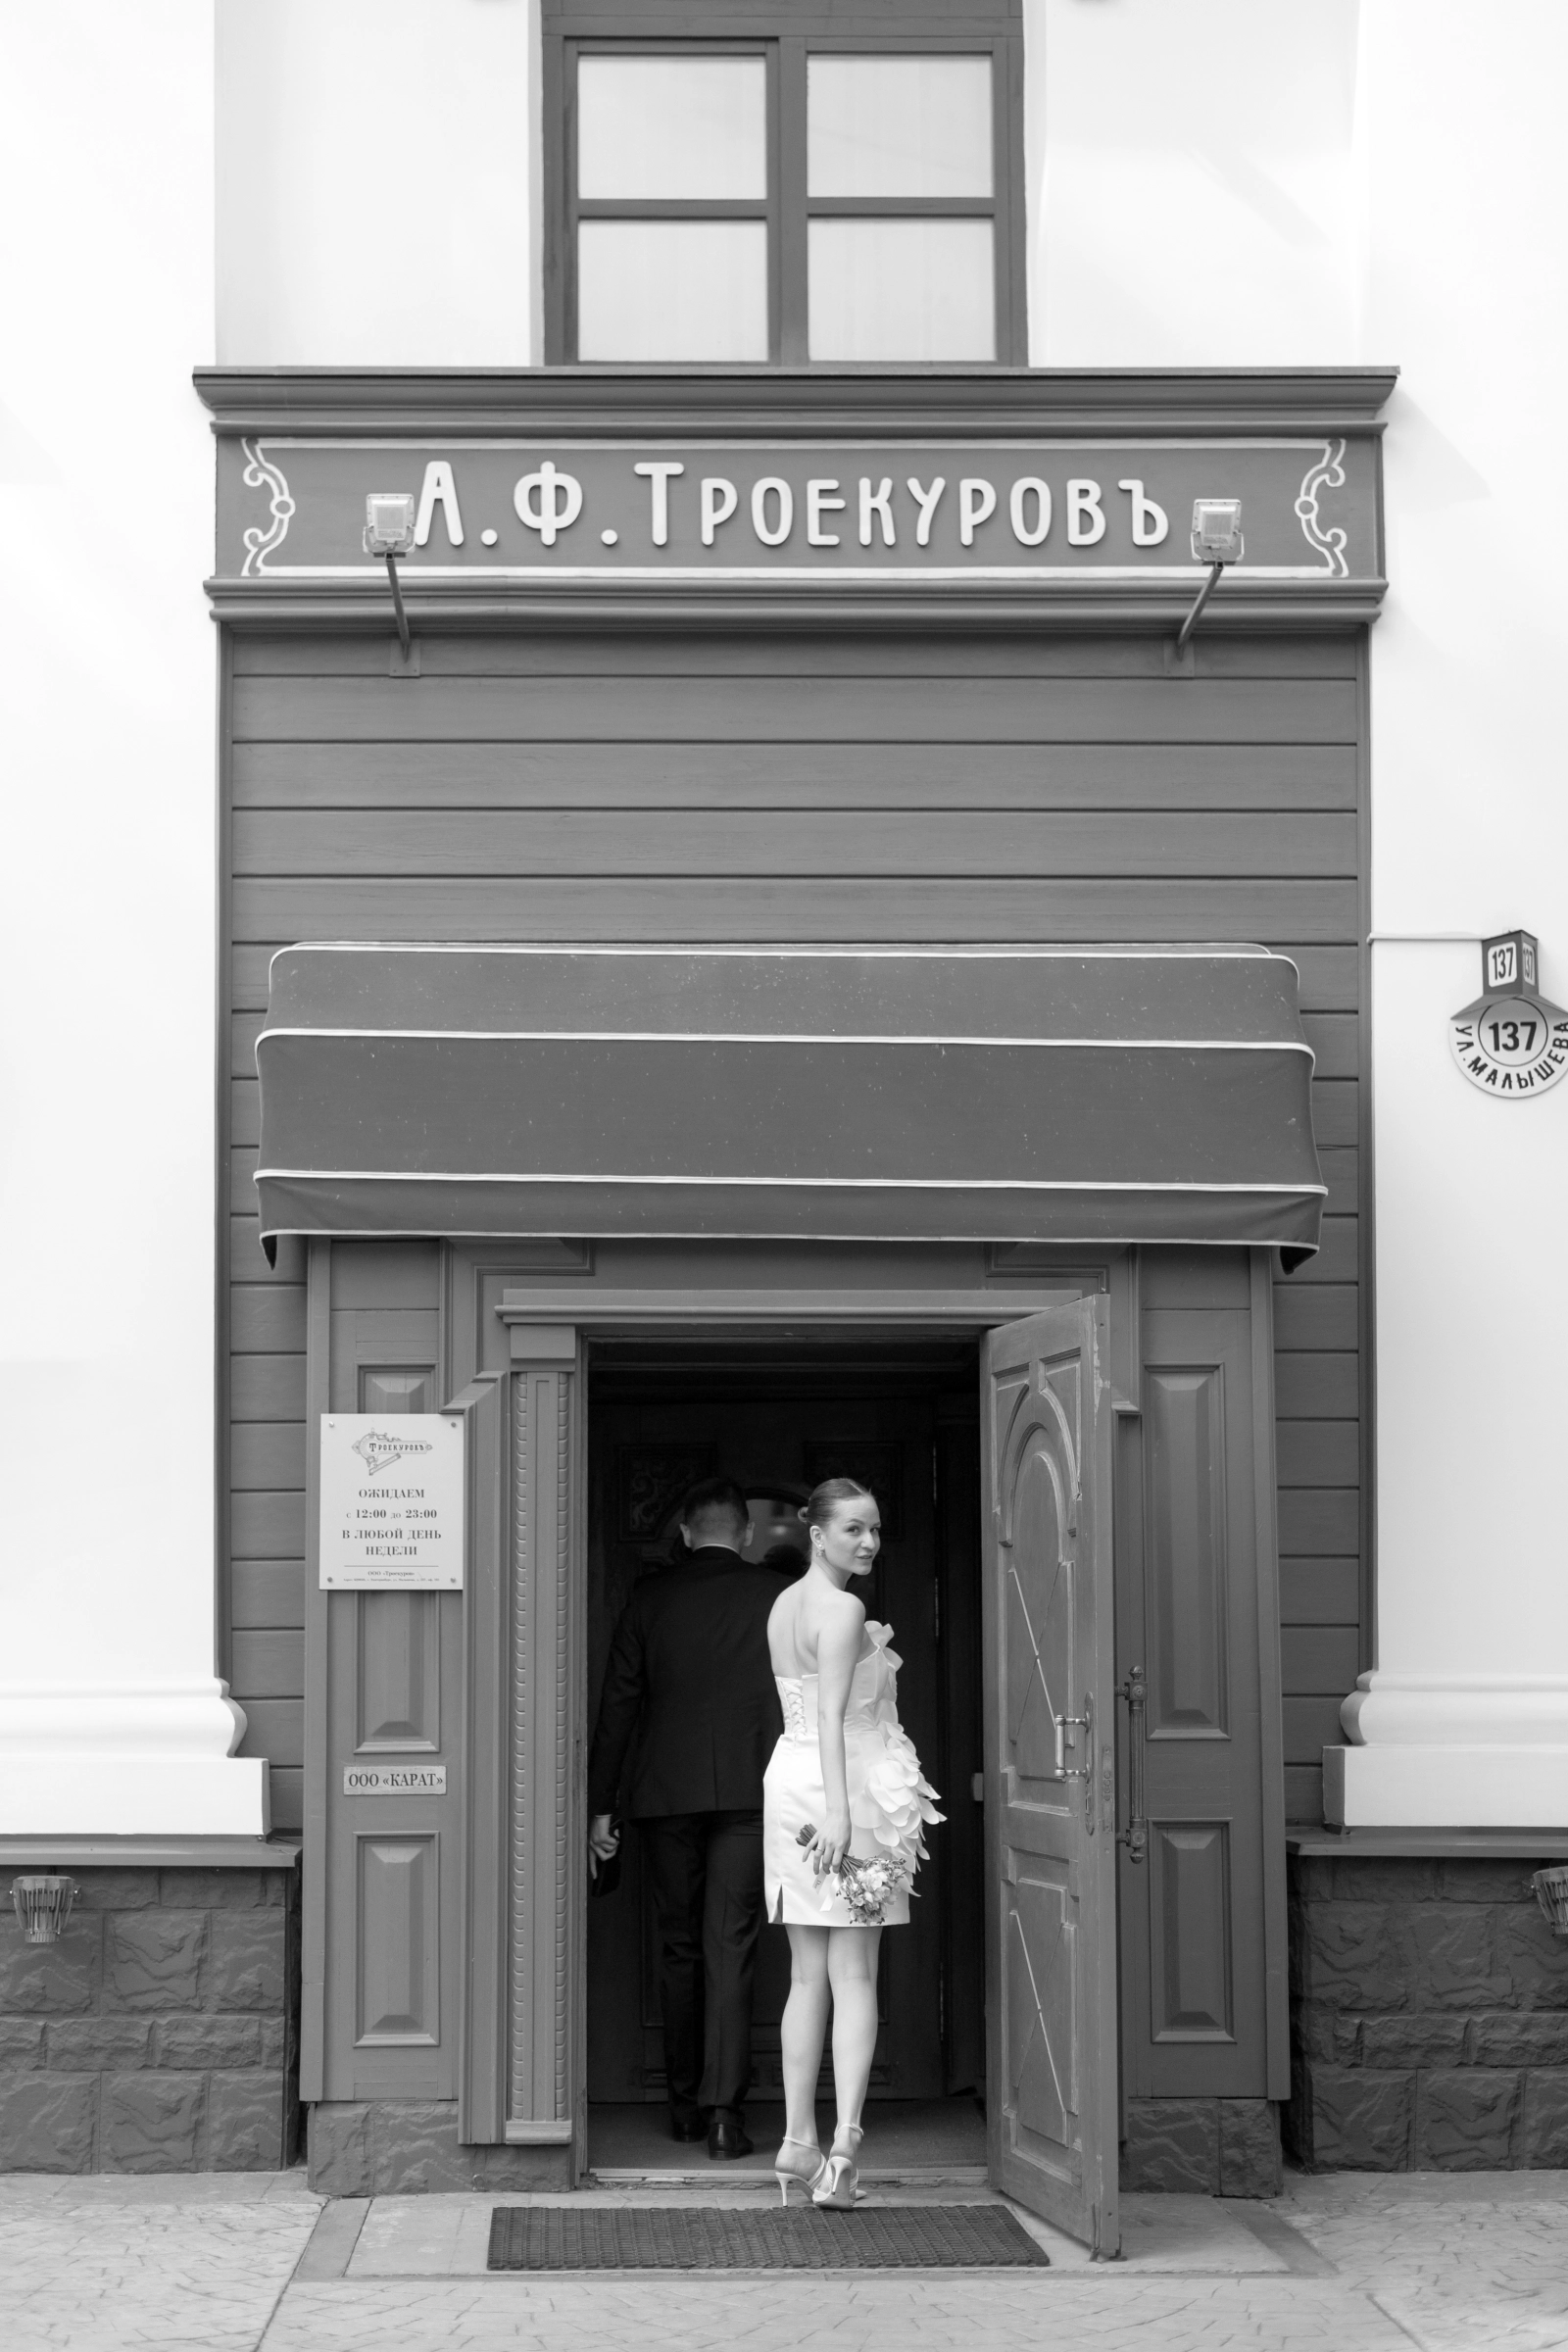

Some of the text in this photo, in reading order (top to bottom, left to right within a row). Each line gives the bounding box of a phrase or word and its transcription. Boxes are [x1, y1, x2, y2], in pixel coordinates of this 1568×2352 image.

[634, 462, 1169, 545] ТРОЕКУРОВЪ
[1492, 947, 1514, 980] 137
[1488, 1021, 1537, 1052] 137
[359, 1489, 425, 1499] ОЖИДАЕМ
[356, 1509, 387, 1519] 12:00
[405, 1509, 438, 1519] 23:00
[342, 1528, 442, 1541] В ЛЮБОЙ ДЕНЬ
[366, 1546, 417, 1556] НЕДЕЛИ
[349, 1773, 443, 1787] ООО «КАРАТ»
